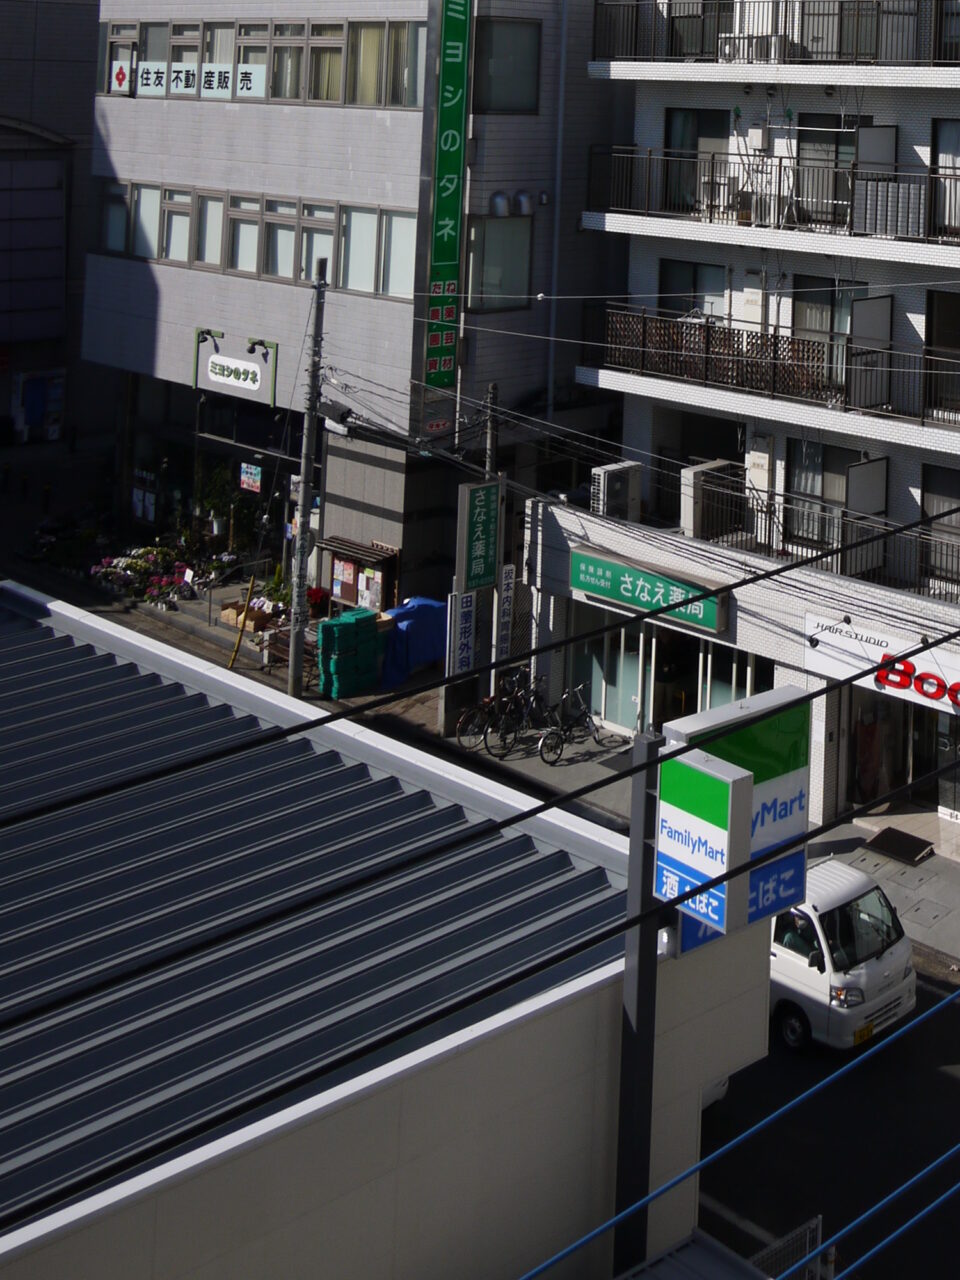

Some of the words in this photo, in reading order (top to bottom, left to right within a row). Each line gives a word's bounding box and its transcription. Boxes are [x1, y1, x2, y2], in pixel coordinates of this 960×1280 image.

[140, 67, 253, 91] 住友不動産販売
[210, 361, 258, 385] ミヨシのタネ
[471, 489, 487, 576] さなえ薬局
[660, 819, 726, 865] FamilyMart
[661, 870, 680, 898] 酒
